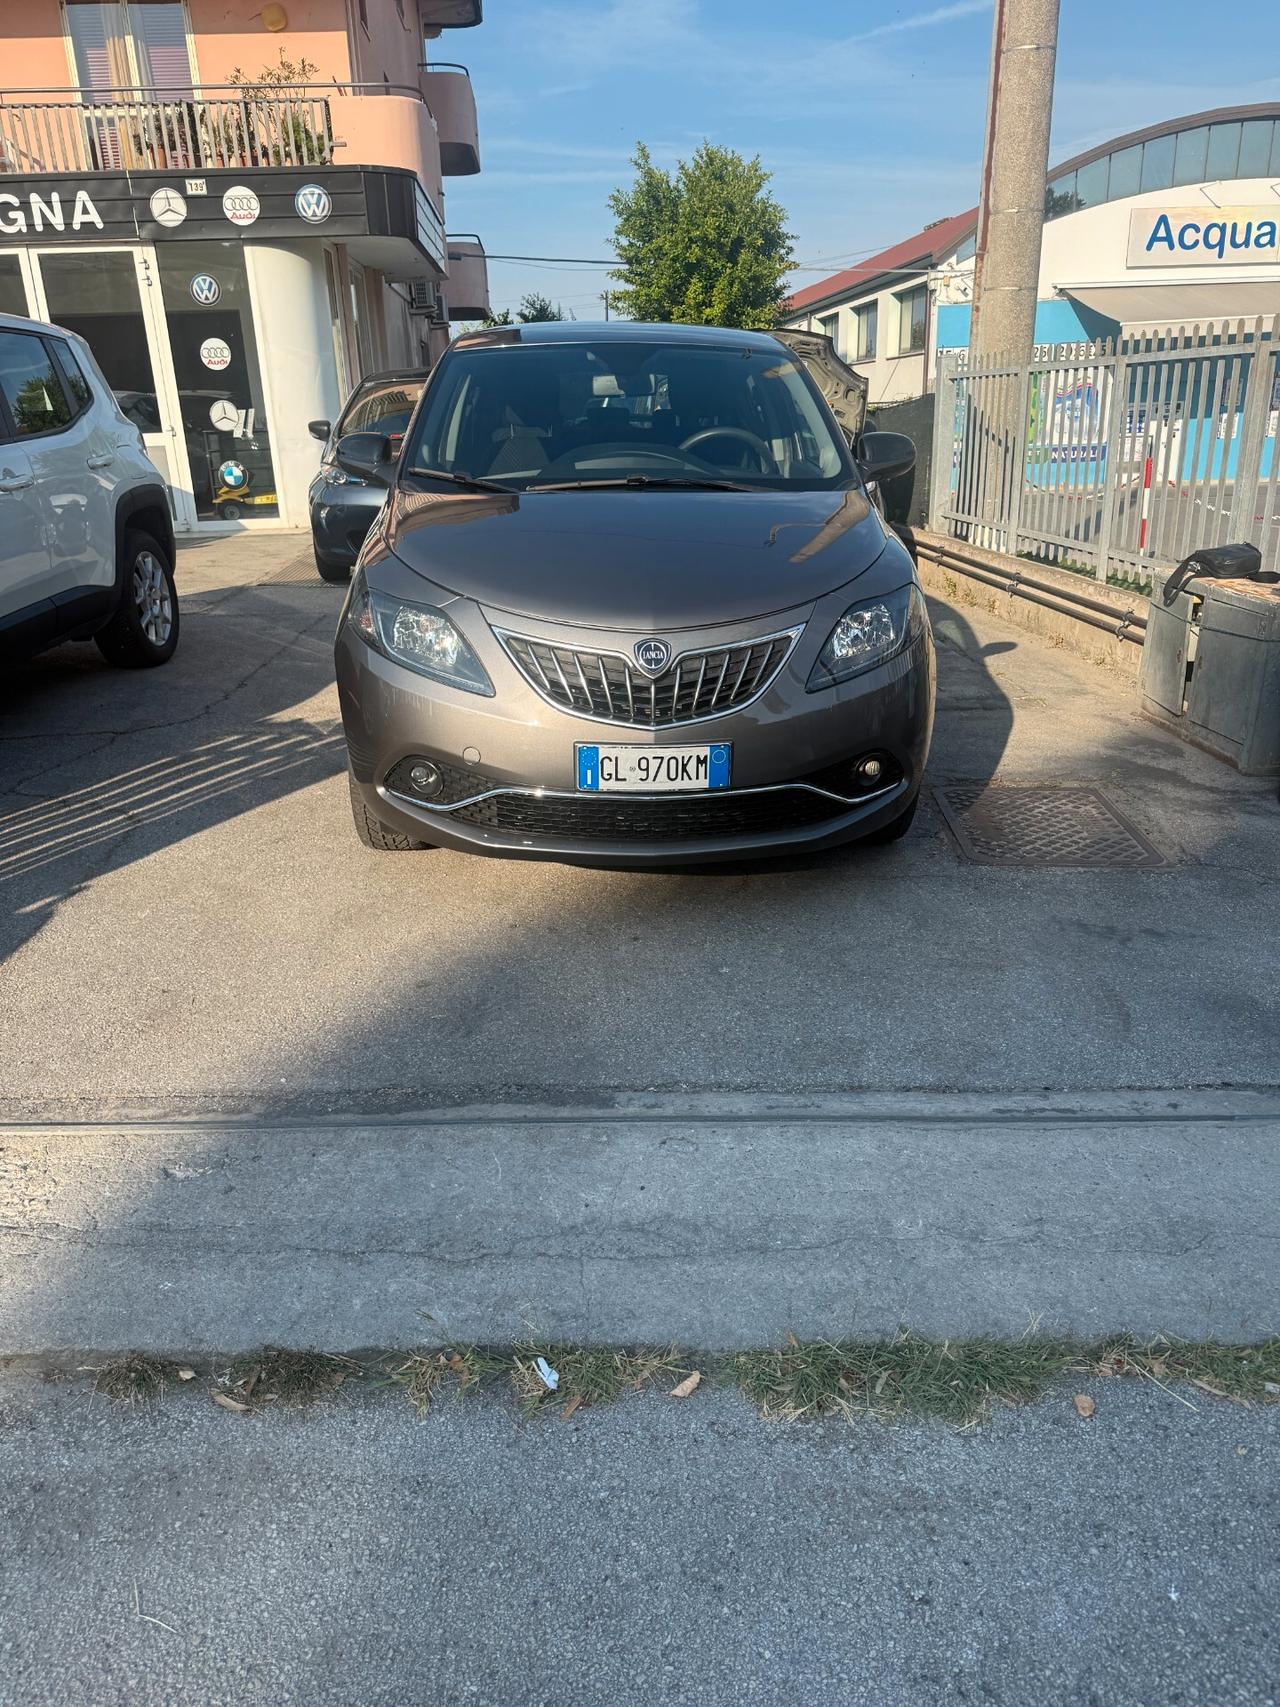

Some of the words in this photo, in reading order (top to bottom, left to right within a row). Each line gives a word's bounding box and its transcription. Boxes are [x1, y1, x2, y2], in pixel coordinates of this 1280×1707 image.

[0, 190, 104, 233] GNA
[230, 211, 256, 220] Audi
[1146, 214, 1276, 259] Acqua
[642, 651, 664, 659] LANCIA
[600, 756, 627, 782] GL
[637, 755, 708, 782] 970KM
